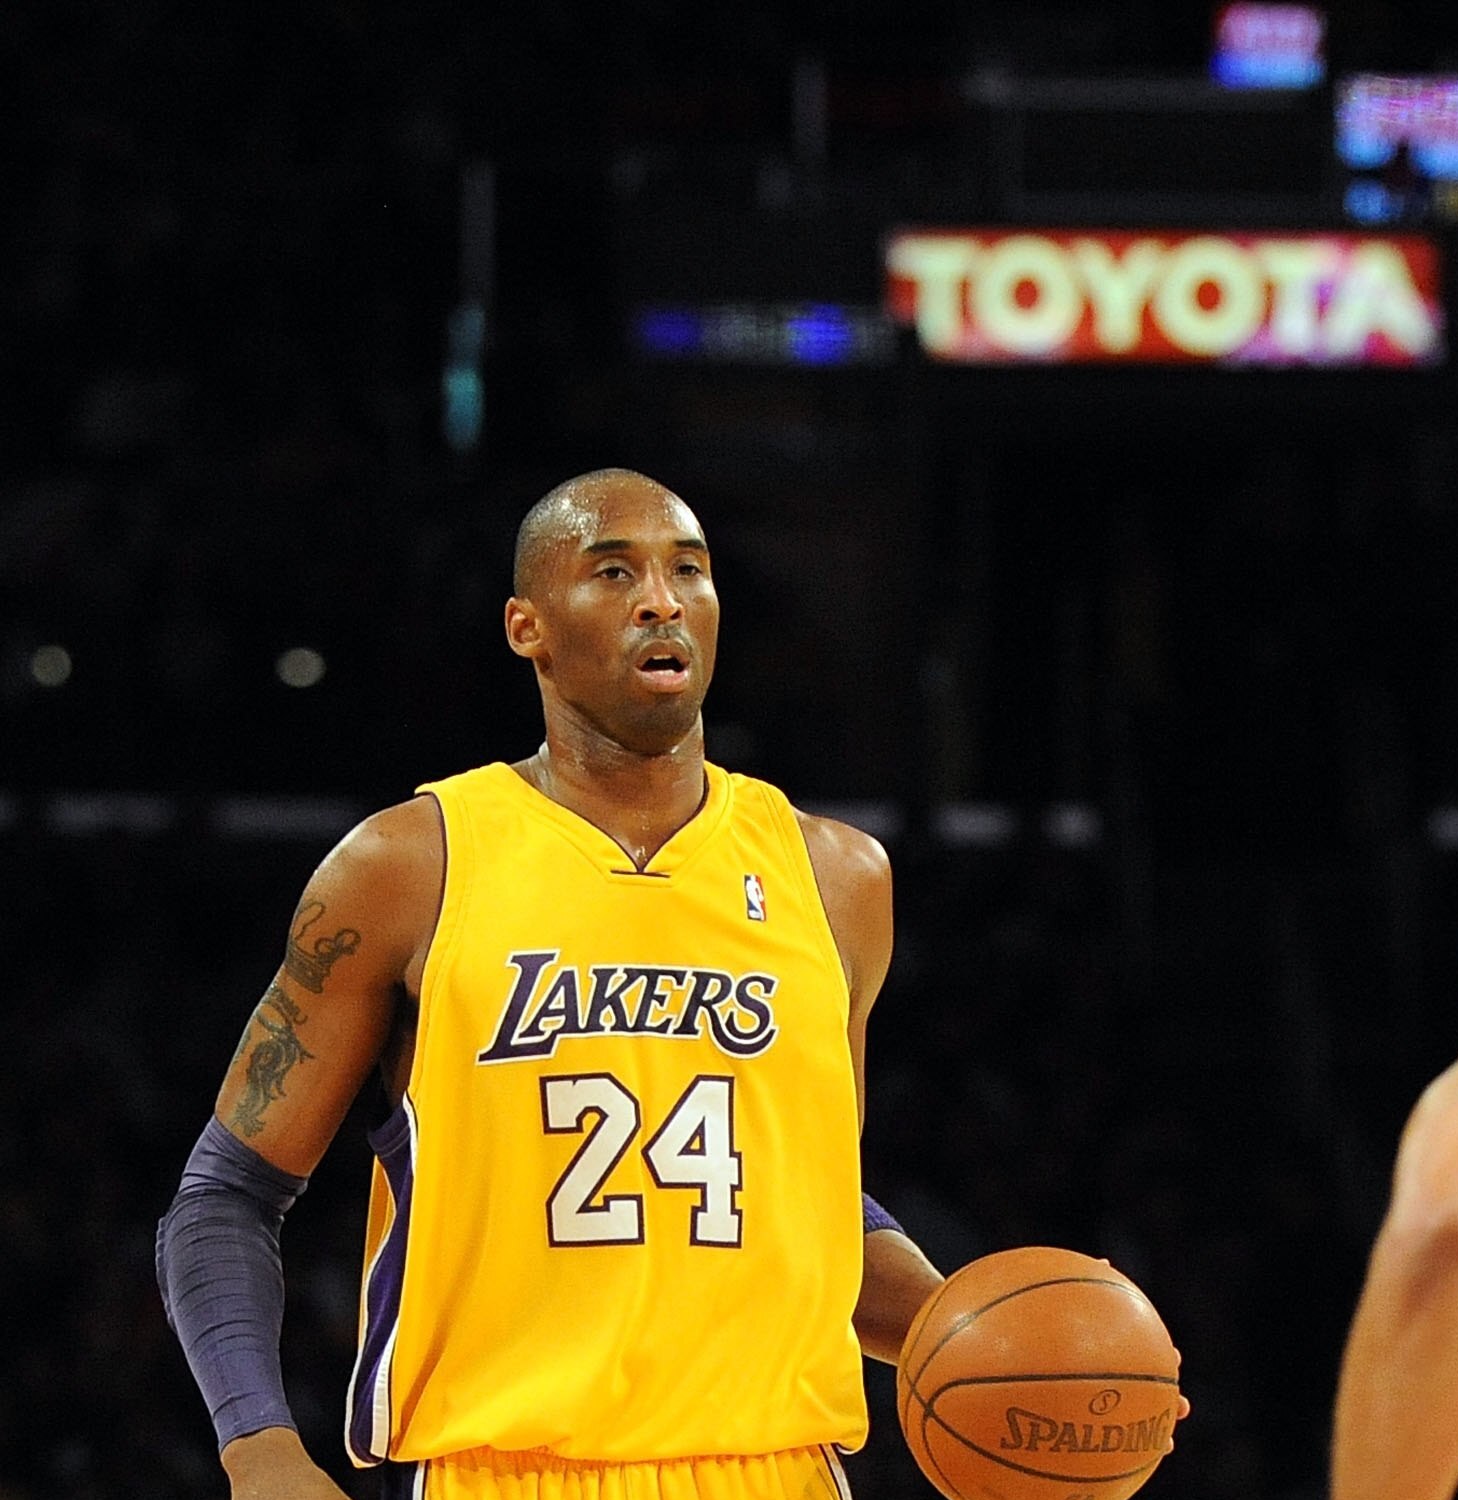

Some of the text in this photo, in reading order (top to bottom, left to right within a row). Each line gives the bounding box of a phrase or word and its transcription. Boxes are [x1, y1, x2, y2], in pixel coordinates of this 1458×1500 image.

[888, 235, 1438, 357] TOYOTA
[475, 949, 780, 1065] LAKERS
[539, 1073, 743, 1248] 24
[1000, 1406, 1172, 1453] SPALDING
